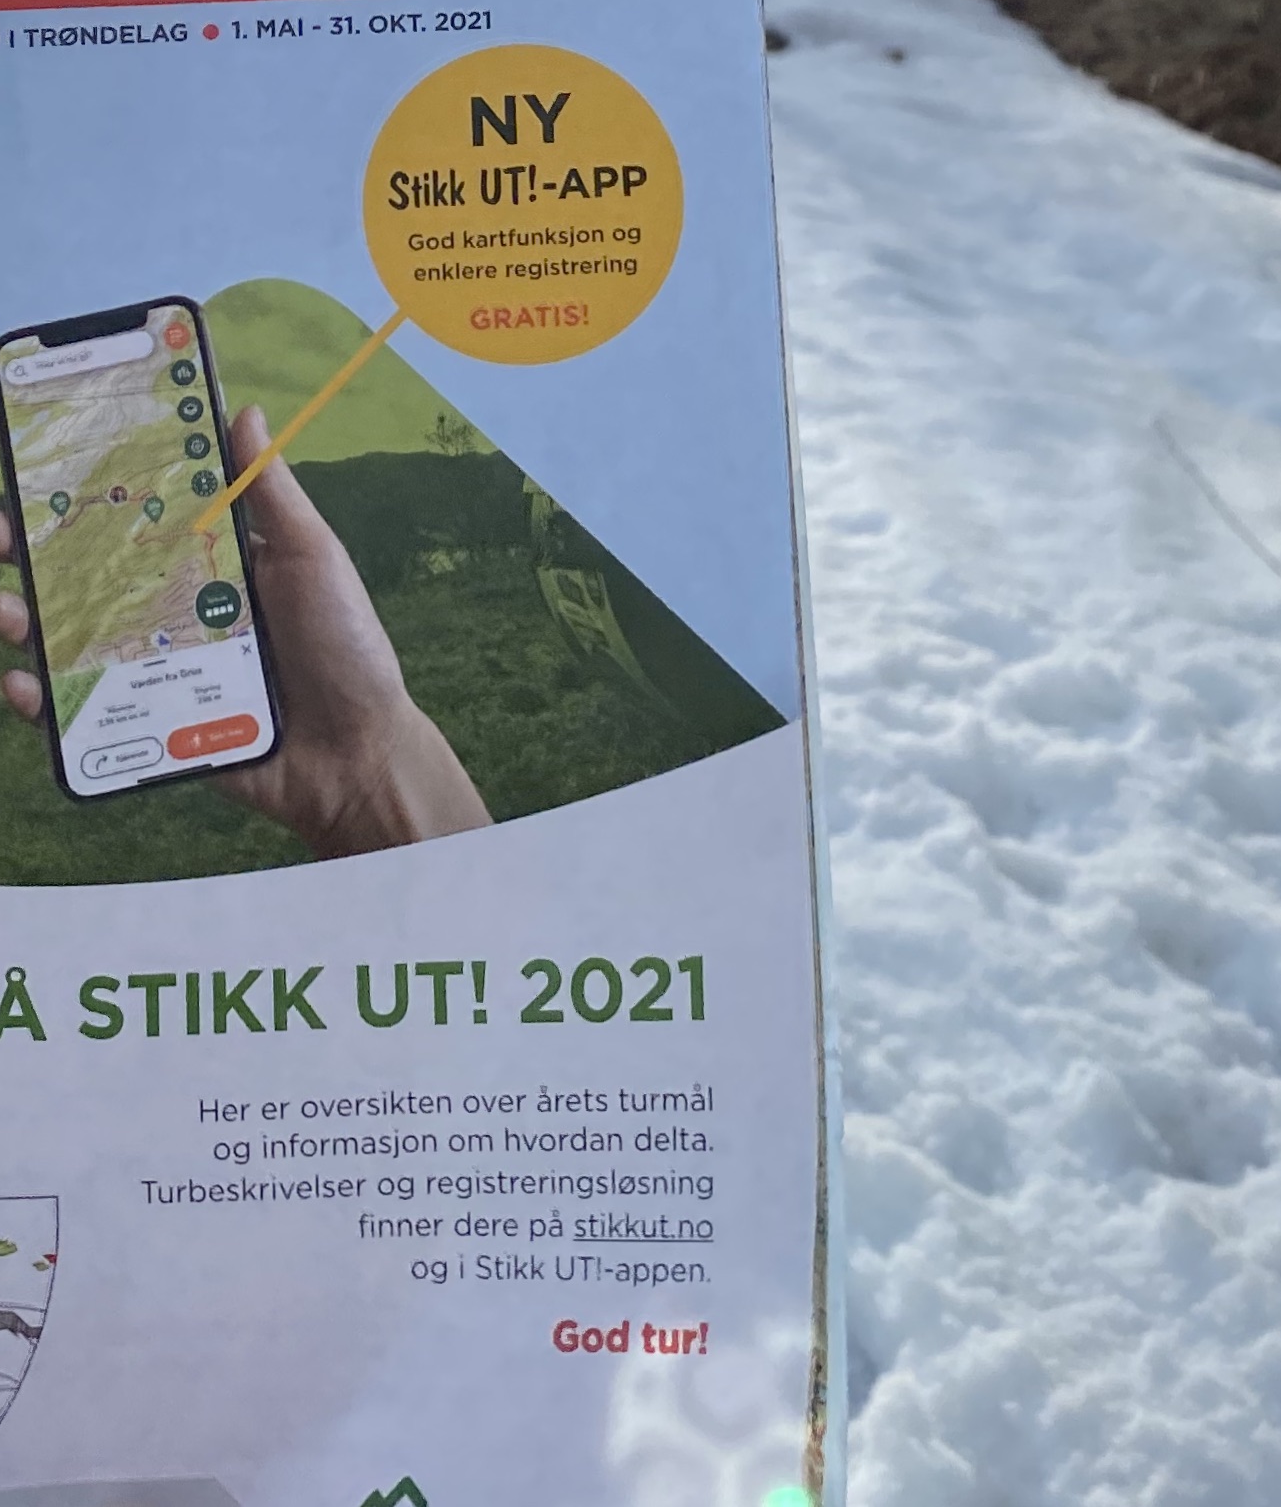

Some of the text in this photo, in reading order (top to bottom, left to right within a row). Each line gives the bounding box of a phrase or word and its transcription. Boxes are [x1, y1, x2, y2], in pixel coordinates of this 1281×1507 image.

[9, 29, 15, 49] I
[23, 23, 188, 48] TRØNDELAG
[231, 20, 248, 40] 1.
[256, 17, 304, 39] MAI
[329, 16, 361, 35] 31.
[368, 13, 427, 34] OKT.
[434, 10, 491, 32] 2021
[470, 92, 572, 147] NY
[388, 164, 648, 211] Stikk UT!-APP
[408, 225, 641, 252] God kartfunksjon og
[414, 255, 638, 282] enklere registrering
[469, 304, 589, 331] GRATIS!
[78, 966, 328, 1040] STIKK
[355, 960, 488, 1029] UT!
[520, 955, 705, 1024] 2021
[199, 1083, 714, 1123] Her er oversikten over årets turmål
[213, 1126, 714, 1165] og informasjon om hvordan delta.
[140, 1169, 714, 1204] Turbeskrivelser og registreringsløsning
[358, 1209, 714, 1243] finner dere på stikkut.no
[410, 1254, 712, 1288] og i Stikk UT!-appen.
[553, 1319, 709, 1355] God tur!
